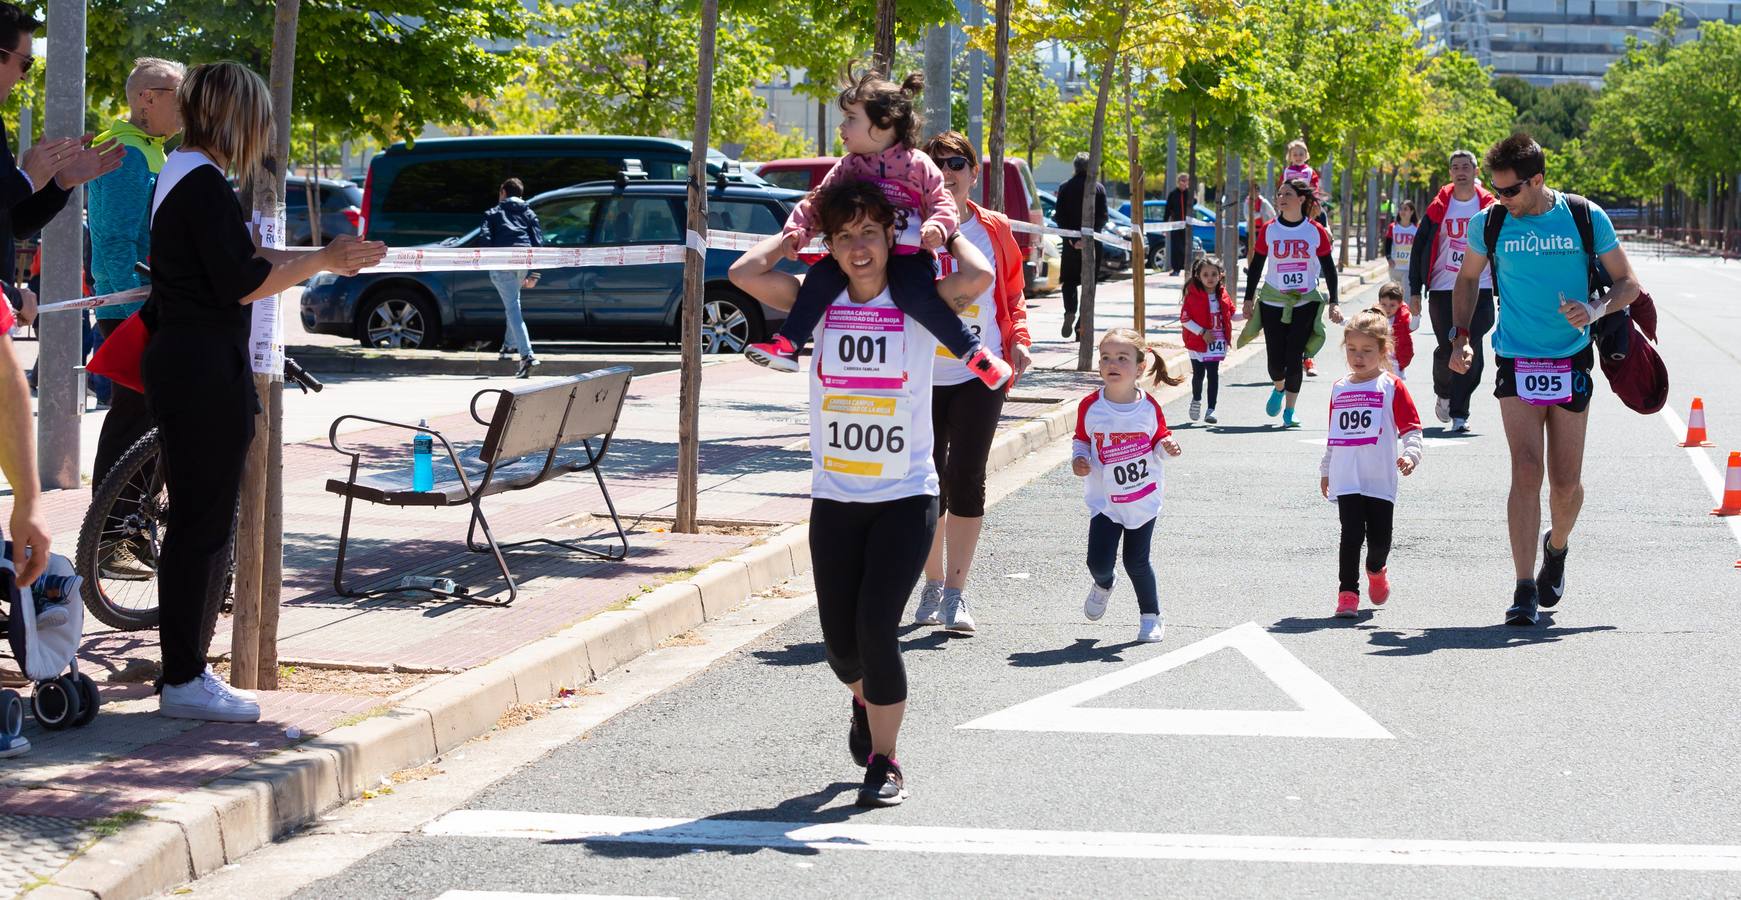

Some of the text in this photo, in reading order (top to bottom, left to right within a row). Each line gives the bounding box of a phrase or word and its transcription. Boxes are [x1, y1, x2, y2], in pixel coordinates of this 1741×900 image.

[1272, 239, 1311, 259] UR
[1452, 251, 1464, 264] 04
[1282, 272, 1304, 285] 043
[830, 309, 879, 318] CARRERA CAMPUS
[838, 335, 886, 364] 001
[1209, 341, 1226, 352] 041
[1524, 374, 1563, 392] 095
[1339, 410, 1372, 430] 096
[828, 421, 905, 454] 1006
[1114, 458, 1149, 485] 082
